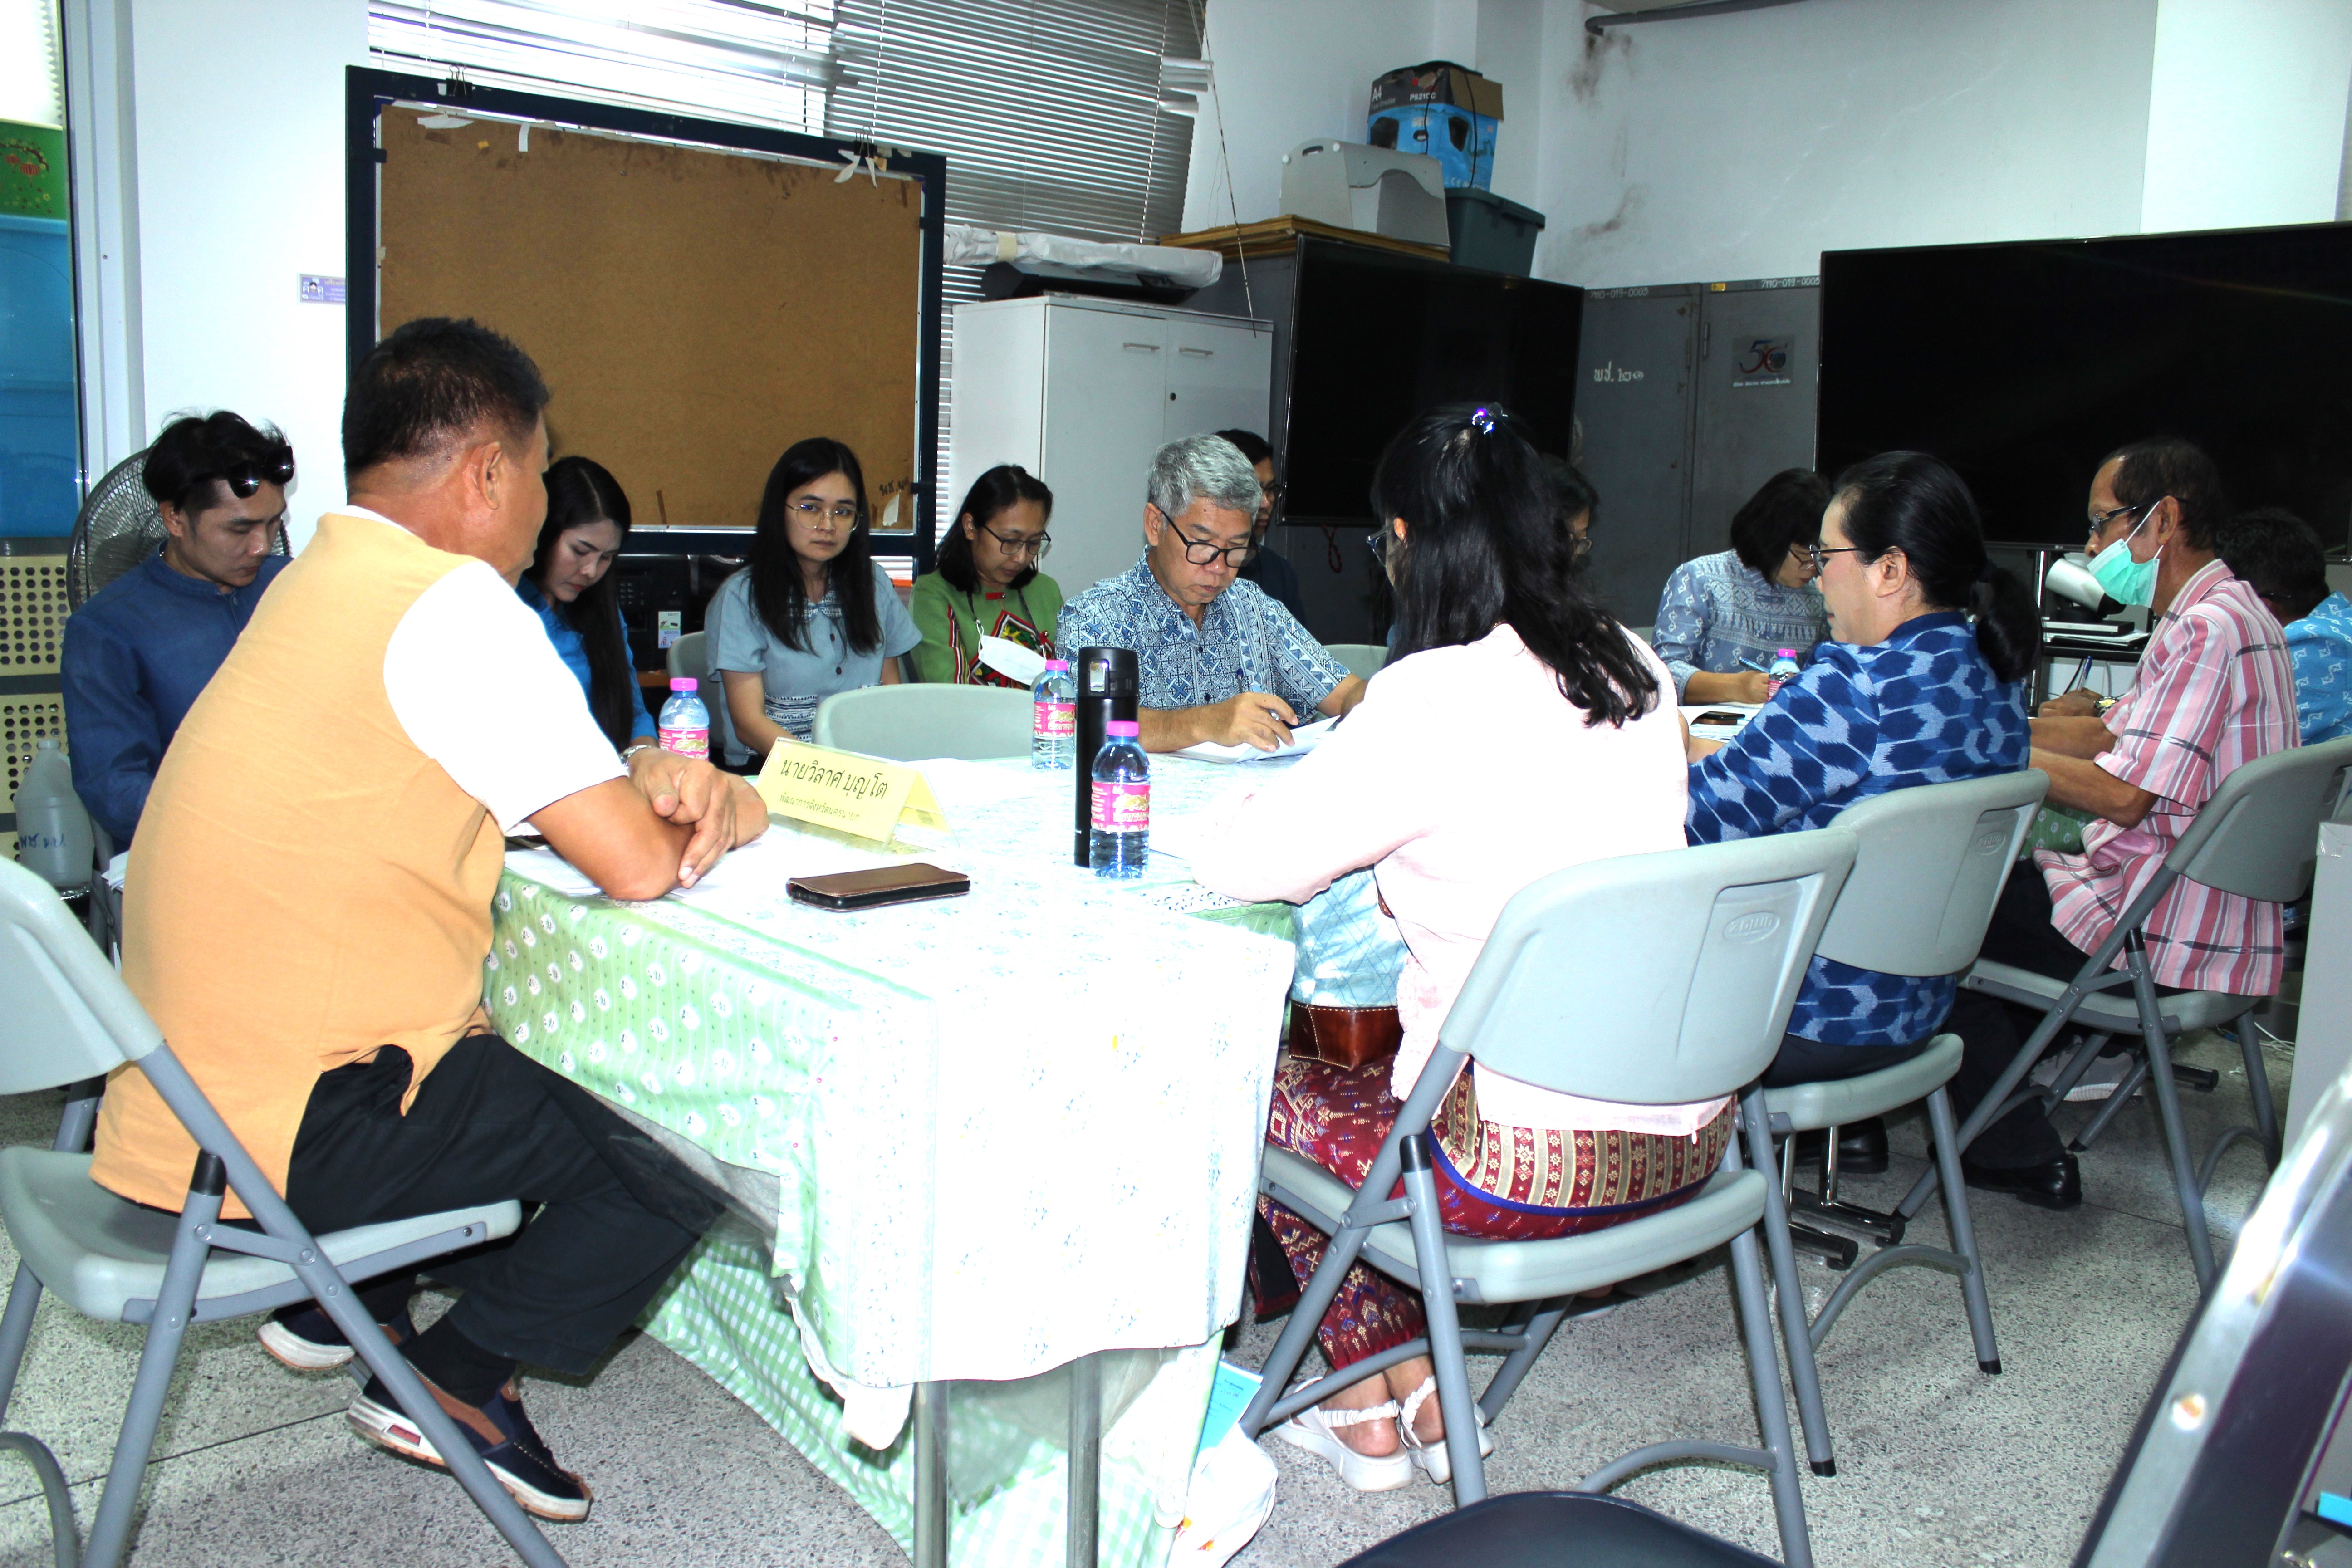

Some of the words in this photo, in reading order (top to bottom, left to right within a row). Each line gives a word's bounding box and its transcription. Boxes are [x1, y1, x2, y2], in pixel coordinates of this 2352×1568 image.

[780, 760, 845, 788] นายวิลาศ
[843, 772, 888, 800] บุญโต
[779, 792, 859, 821] พัฒนาการจังหวัดนครนายก
